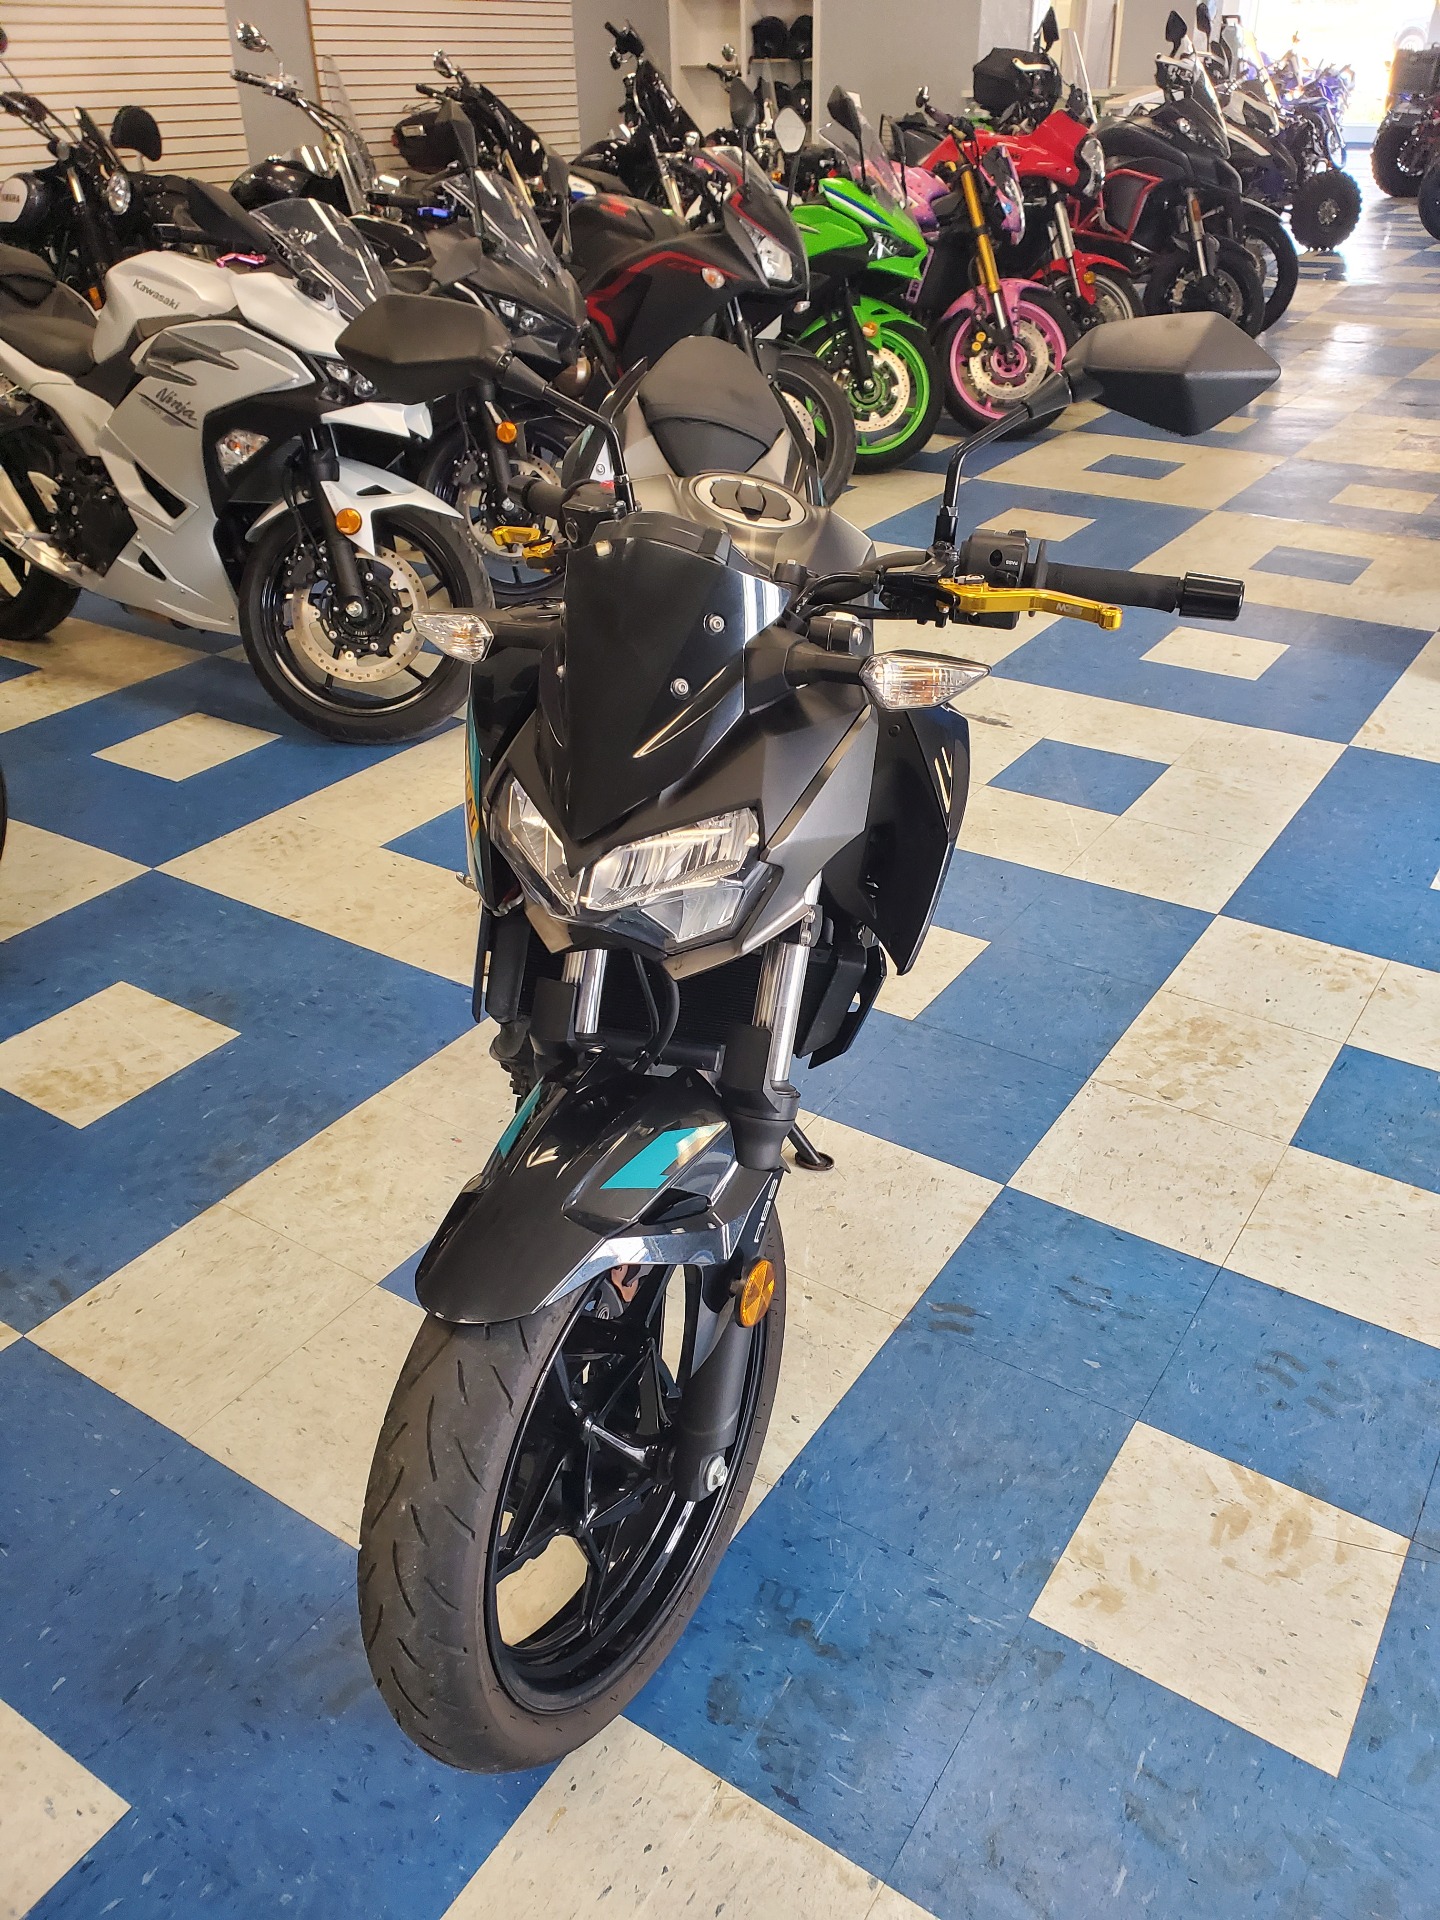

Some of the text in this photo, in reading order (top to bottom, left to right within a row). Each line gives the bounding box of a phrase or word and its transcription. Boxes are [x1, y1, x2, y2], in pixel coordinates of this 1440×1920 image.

[132, 279, 181, 310] Kawasaki
[155, 387, 197, 421] Ninja
[753, 1178, 778, 1243] ABS
